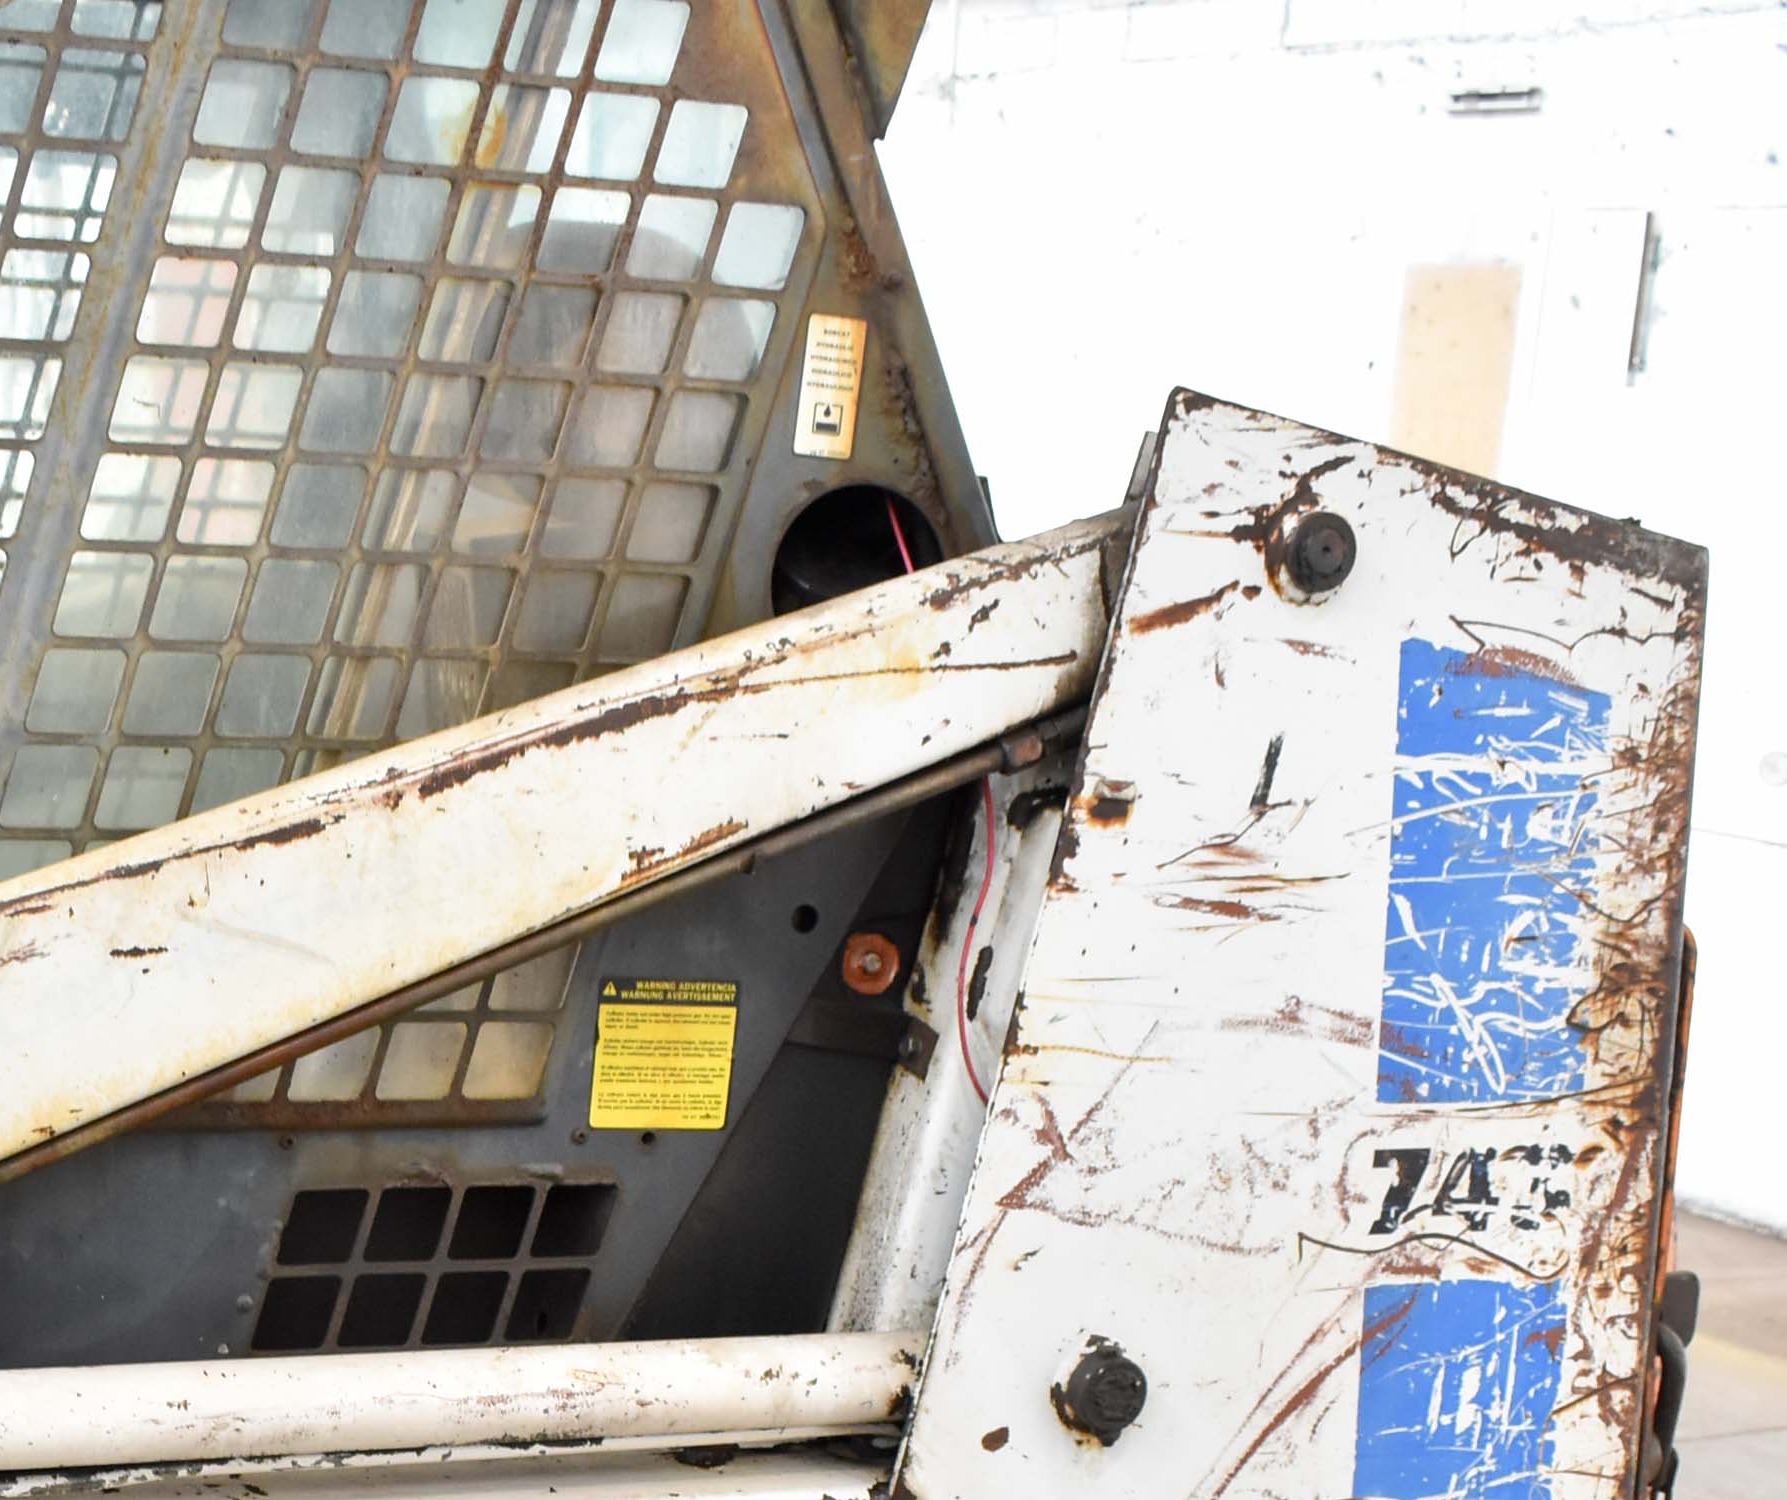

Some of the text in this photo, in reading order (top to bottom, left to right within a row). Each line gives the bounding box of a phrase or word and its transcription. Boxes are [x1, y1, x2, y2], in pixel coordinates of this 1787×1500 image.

[636, 980, 737, 992] WARNING ADVERTENCIA
[621, 990, 736, 1002] WARNUNG AVERTISSEMENT
